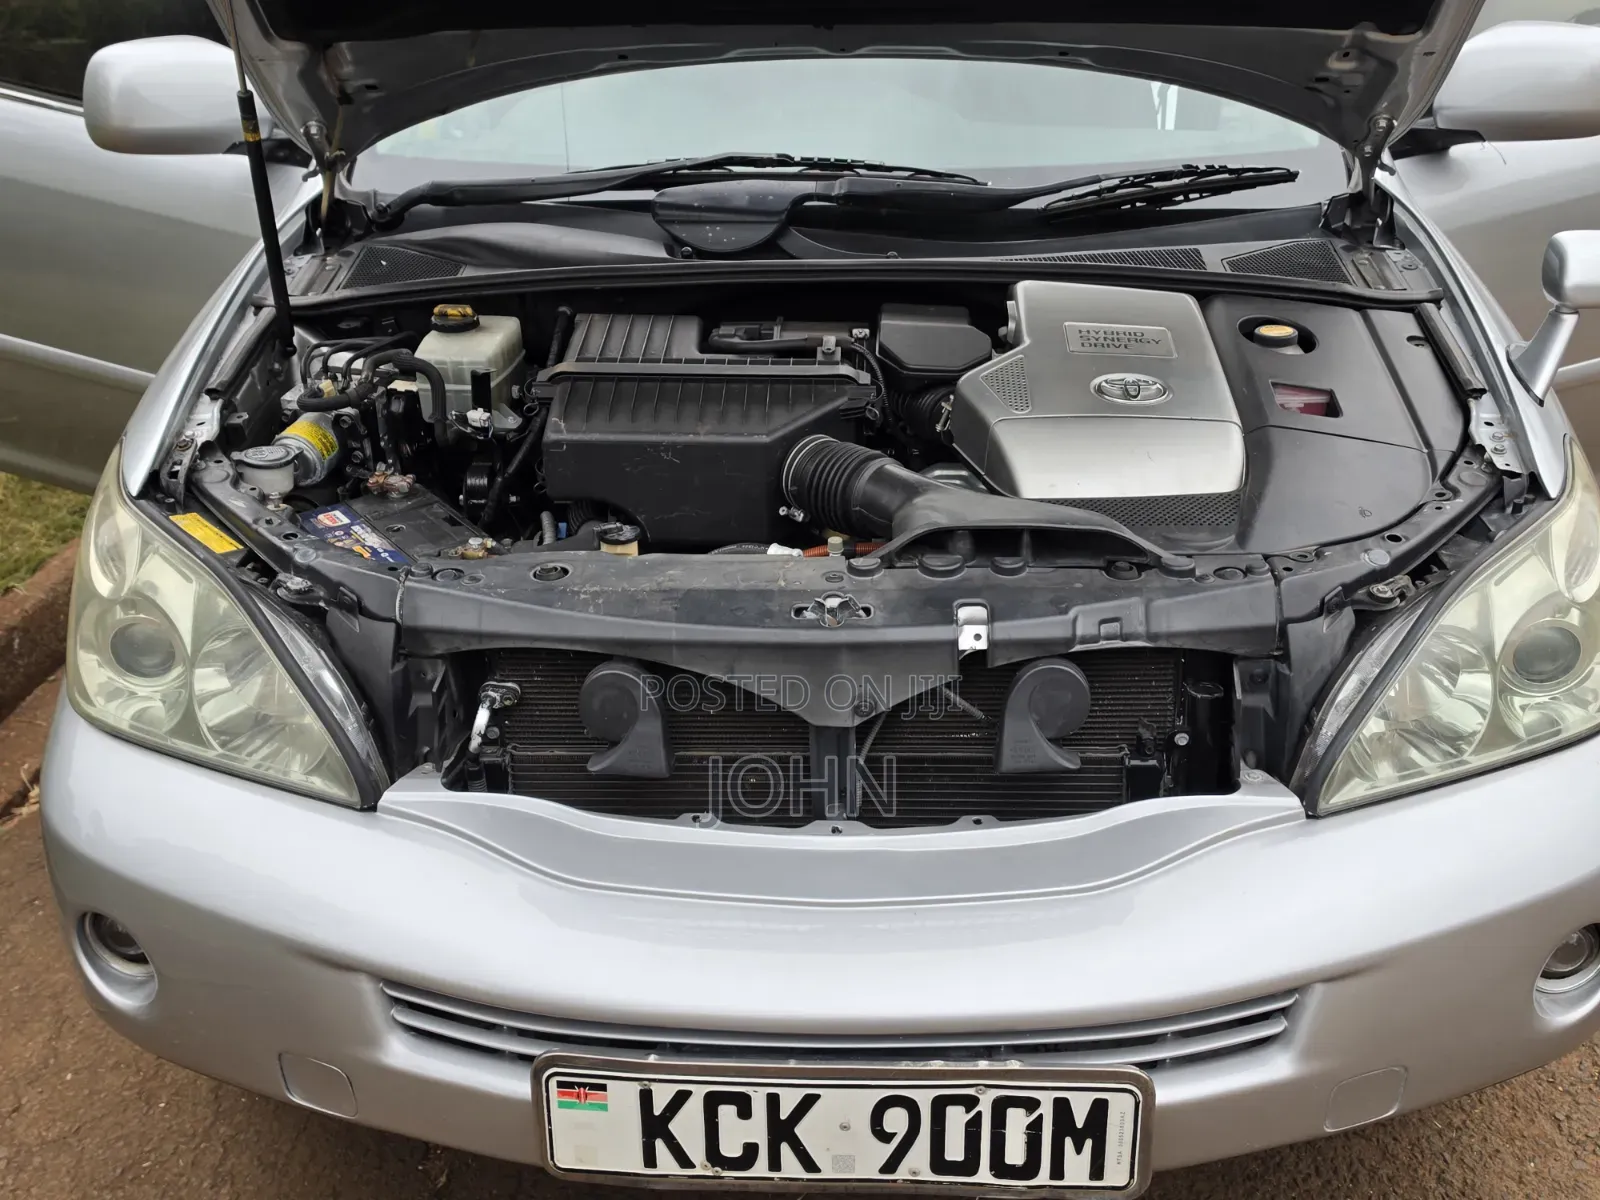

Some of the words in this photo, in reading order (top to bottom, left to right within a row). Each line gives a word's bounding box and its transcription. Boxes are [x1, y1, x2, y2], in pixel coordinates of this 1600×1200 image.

[1078, 329, 1145, 337] HYBRID
[1079, 335, 1162, 345] SYNERGY
[638, 1088, 822, 1174] KCK
[870, 1094, 1109, 1181] 900M
